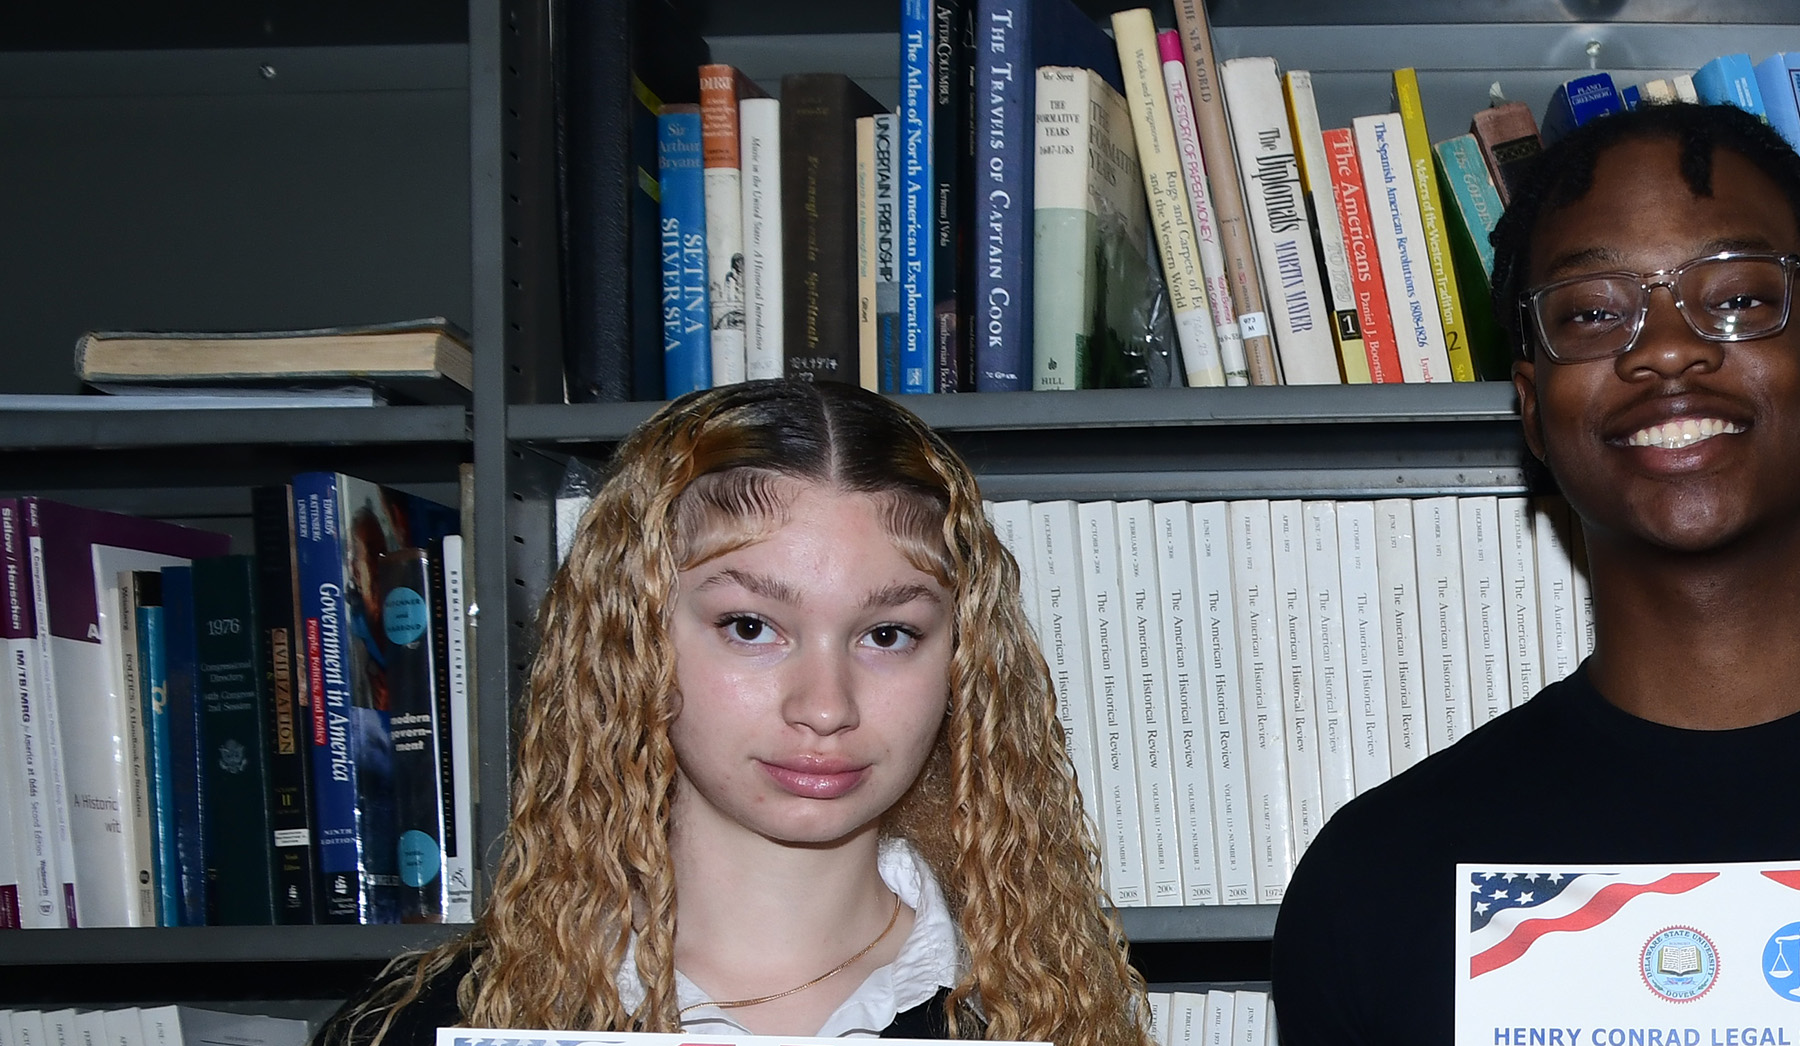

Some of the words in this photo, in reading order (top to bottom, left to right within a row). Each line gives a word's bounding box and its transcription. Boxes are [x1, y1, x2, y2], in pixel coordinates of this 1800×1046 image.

[907, 30, 922, 61] The
[990, 10, 1014, 54] THE
[907, 65, 922, 108] Atlas
[988, 62, 1014, 152] TRAVELS
[1049, 100, 1067, 110] THE
[907, 109, 922, 127] of
[1036, 113, 1080, 125] FORMATIVE
[1044, 126, 1070, 137] YEARS
[1257, 127, 1281, 151] The
[1374, 122, 1387, 143] The
[876, 117, 891, 199] UNCERTAIN
[907, 128, 922, 176] North
[989, 156, 1005, 183] OF
[1333, 138, 1354, 176] The
[1377, 143, 1393, 184] Spanish
[1251, 153, 1307, 234] Diplomats
[1386, 187, 1402, 235] American
[907, 180, 922, 254] American
[988, 190, 1010, 281] CAPTAIN
[1341, 181, 1372, 282] Americans
[662, 217, 680, 304] SILVER
[683, 233, 704, 281] SET
[878, 201, 893, 283] FRIENDSHIP
[1273, 240, 1304, 287] MARTIN
[1396, 237, 1415, 299] Revolutions
[684, 285, 705, 313] IN
[906, 260, 921, 352] Exploration
[988, 287, 1010, 348] COOK
[1284, 287, 1314, 334] MAYER
[1360, 292, 1375, 327] Daniel
[664, 306, 681, 352] SEA
[685, 316, 704, 334] A
[1342, 315, 1354, 333] 1
[1408, 300, 1429, 348] 1808-1826
[1369, 340, 1383, 383] Boorstin
[1096, 590, 1108, 614] The
[207, 620, 240, 635] 1976
[319, 582, 345, 692] Government
[1099, 617, 1111, 671] American
[326, 690, 350, 707] in
[1103, 675, 1116, 729] Historical
[326, 710, 354, 782] America
[1109, 731, 1121, 773] Review
[1644, 937, 1663, 978] DELAWARE
[1692, 934, 1715, 978] UNIVERSITY
[1665, 990, 1695, 998] DOVER
[1493, 1027, 1582, 1046] HENRY
[1711, 1026, 1791, 1046] LEGAL
